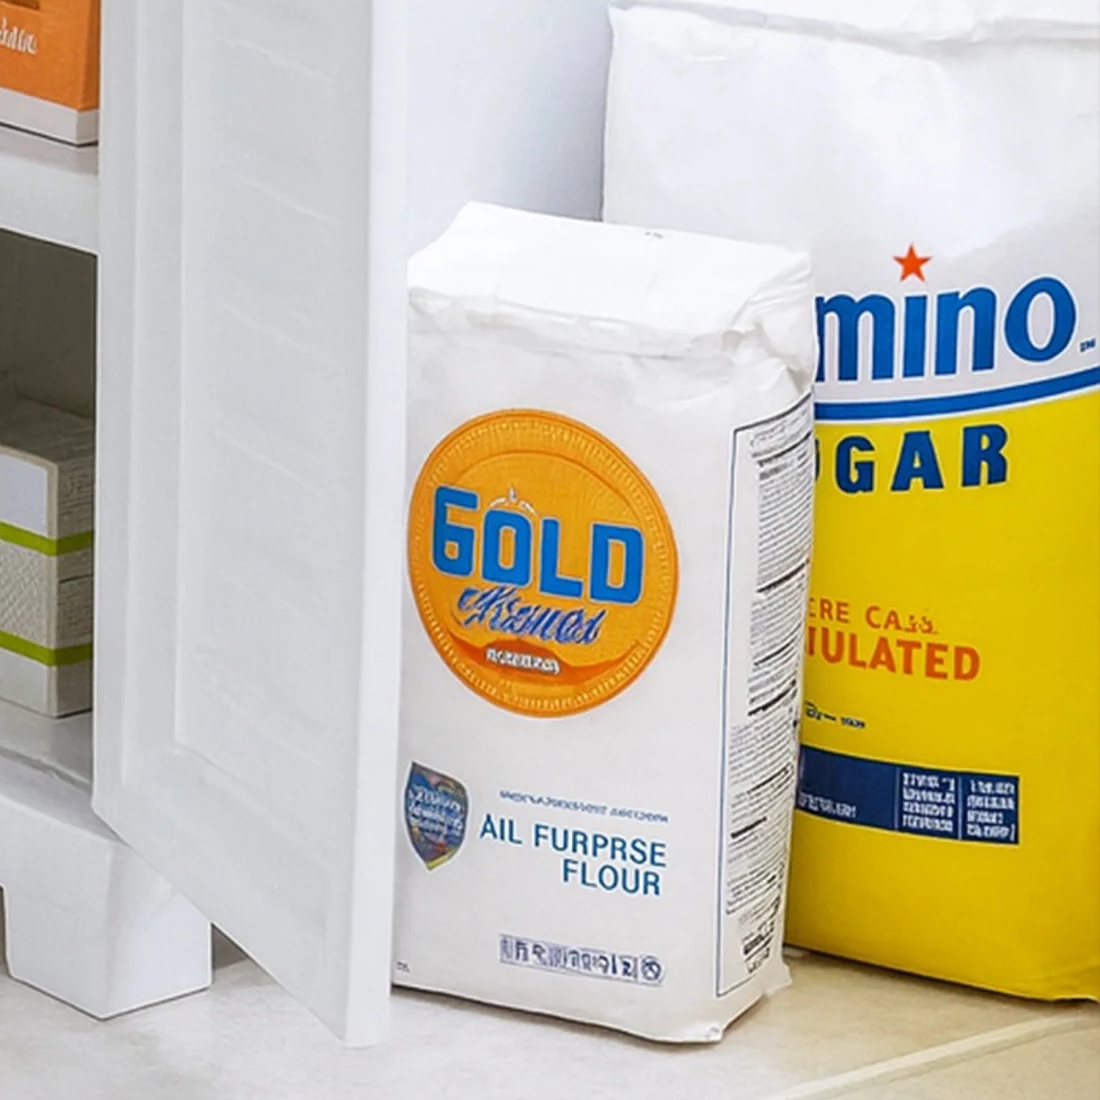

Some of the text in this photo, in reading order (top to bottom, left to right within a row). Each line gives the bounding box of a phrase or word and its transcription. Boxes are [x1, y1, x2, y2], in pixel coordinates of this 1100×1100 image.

[814, 277, 1077, 382] mino
[814, 424, 1008, 494] GAR
[534, 823, 667, 867] FURPRSE
[562, 858, 661, 896] FLOUR
